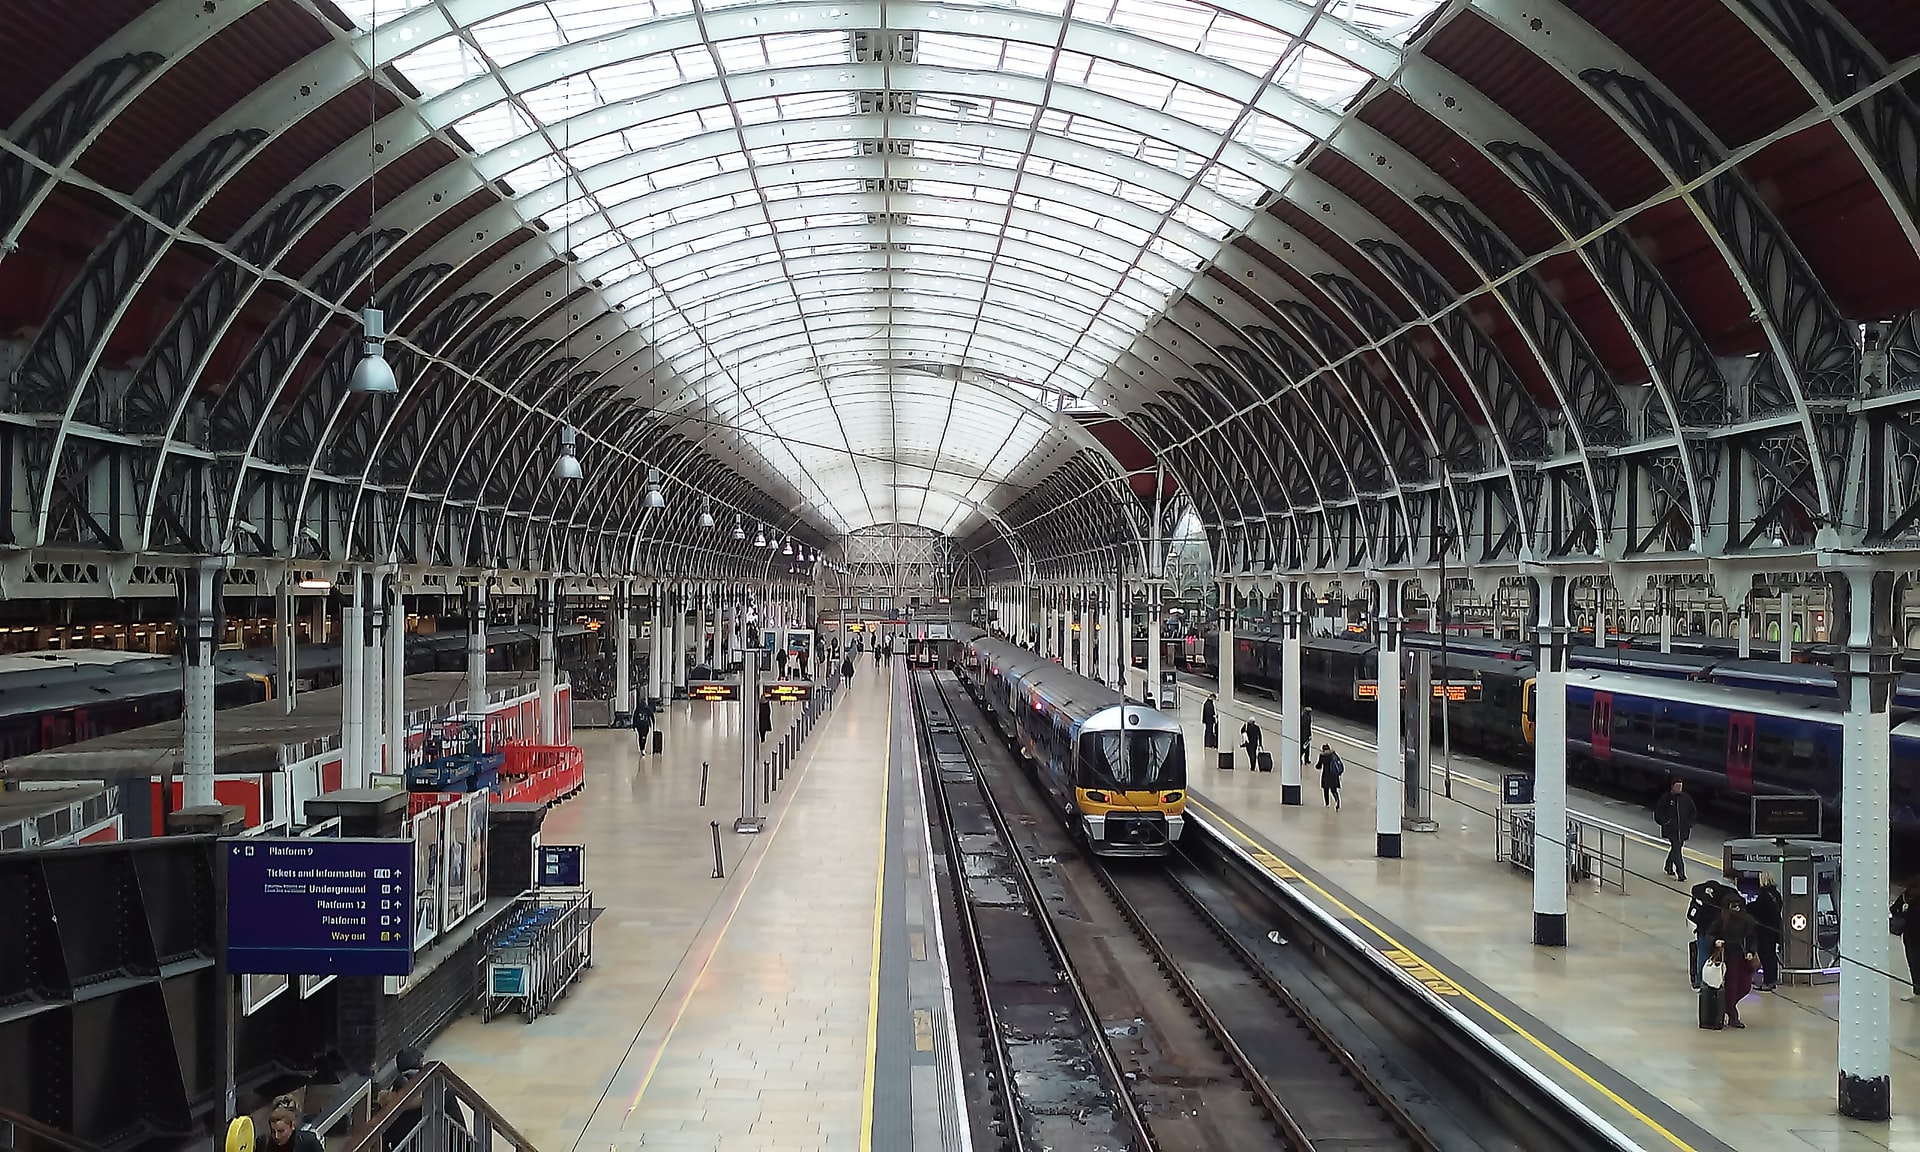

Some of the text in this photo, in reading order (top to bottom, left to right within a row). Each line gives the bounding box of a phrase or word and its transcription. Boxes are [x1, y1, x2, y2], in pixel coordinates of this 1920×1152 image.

[1409, 652, 1415, 674] 7
[269, 846, 314, 856] Platform 9
[267, 868, 296, 878] Tickets
[298, 868, 314, 878] and
[309, 885, 366, 895] Underground
[317, 900, 366, 909] Platform 12
[322, 916, 358, 925] Platform
[331, 932, 366, 942] Way out
